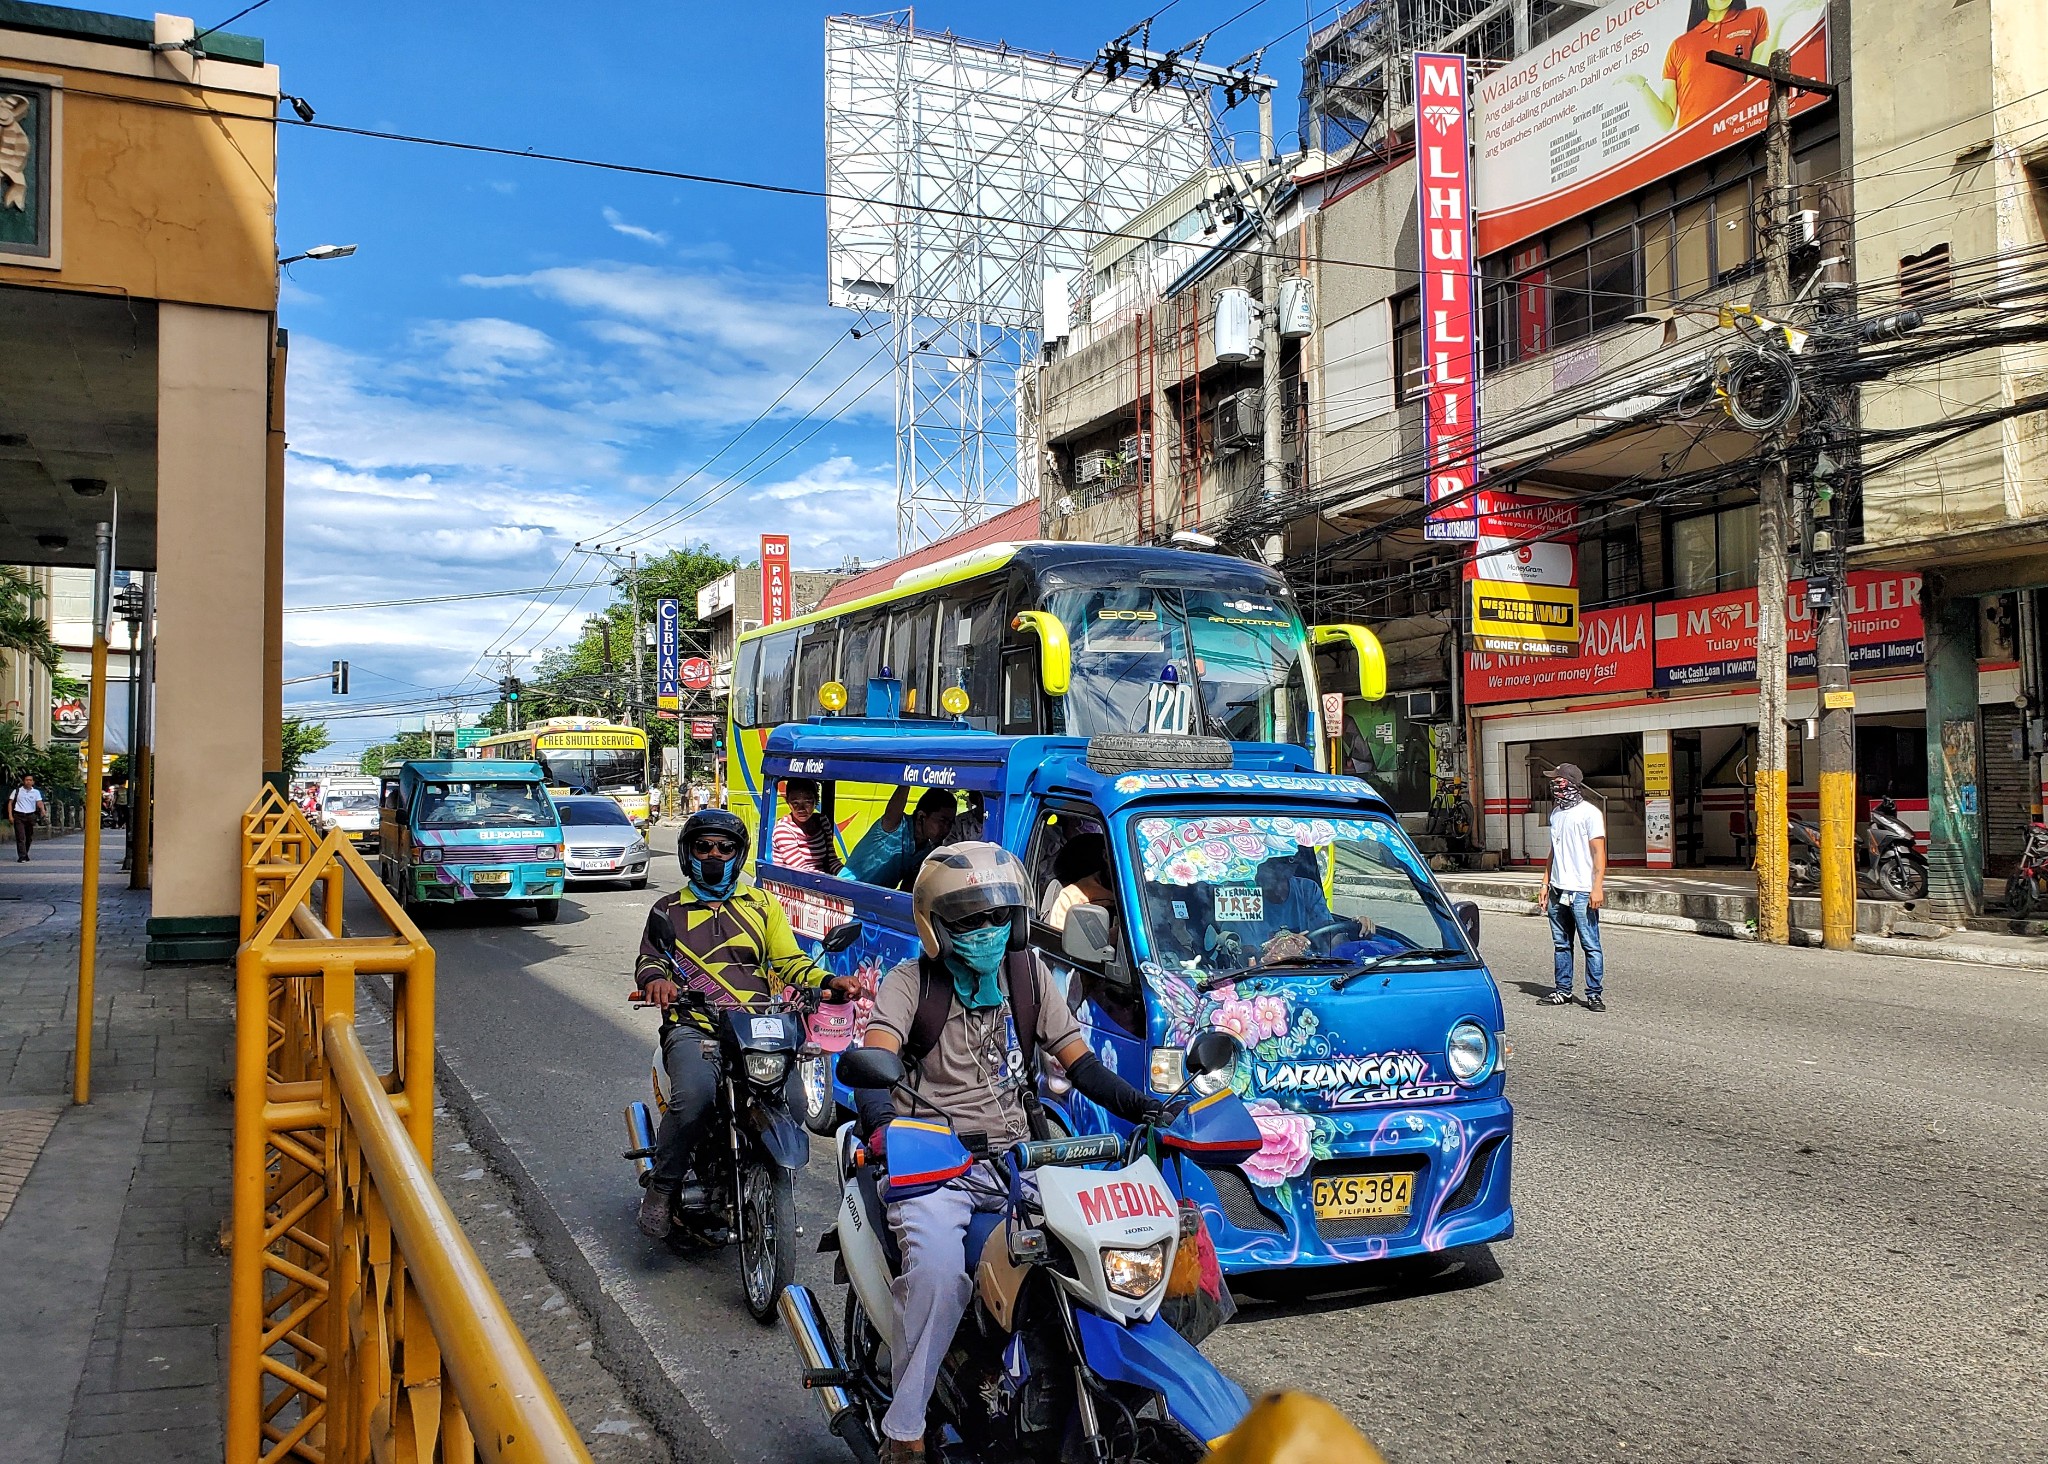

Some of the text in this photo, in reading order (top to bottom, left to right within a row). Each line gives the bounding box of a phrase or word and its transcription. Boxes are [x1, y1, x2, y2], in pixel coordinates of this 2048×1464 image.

[1482, 0, 1661, 104] Walang cheche burec
[1422, 64, 1460, 97] M
[1484, 28, 1644, 124] Ang dali-dali ng forms. Ang liit-liit ng fees.
[1485, 42, 1650, 141] Ang dali-daling puntahan. Dahil over 1,850
[1573, 109, 1592, 125] Services
[1485, 102, 1578, 159] ang branches nationwide.
[1733, 124, 1745, 135] Ang
[1537, 507, 1573, 525] PADALA
[765, 543, 785, 555] RD
[1481, 599, 1568, 624] WESTERN WU
[1497, 609, 1534, 622] UNION
[660, 601, 677, 693] CEBUANA
[1485, 639, 1569, 654] MONEY CHANGER
[1706, 638, 1740, 652] Tulay
[1669, 669, 1687, 681] Quick
[1688, 666, 1704, 678] Cash
[1705, 664, 1721, 676] Loan
[1726, 661, 1756, 675] KWARTA
[1860, 647, 1881, 660] Plans
[1888, 644, 1915, 658] Money
[1488, 661, 1618, 688] We move your money fast!
[543, 735, 635, 746] FREE SHUTTLE SERVICE
[804, 758, 824, 774] Nicole
[903, 765, 957, 786] Ken Cendric
[1254, 774, 1384, 800] BEAUTIFU
[1218, 896, 1262, 913] TRES
[1255, 1054, 1423, 1092] LABANGON
[1056, 1144, 1098, 1163] Option
[845, 1193, 863, 1233] HONDA
[1077, 1181, 1174, 1226] MEDIA
[1339, 1207, 1383, 1215] PILIPINAS
[1125, 1225, 1154, 1235] HONDA
